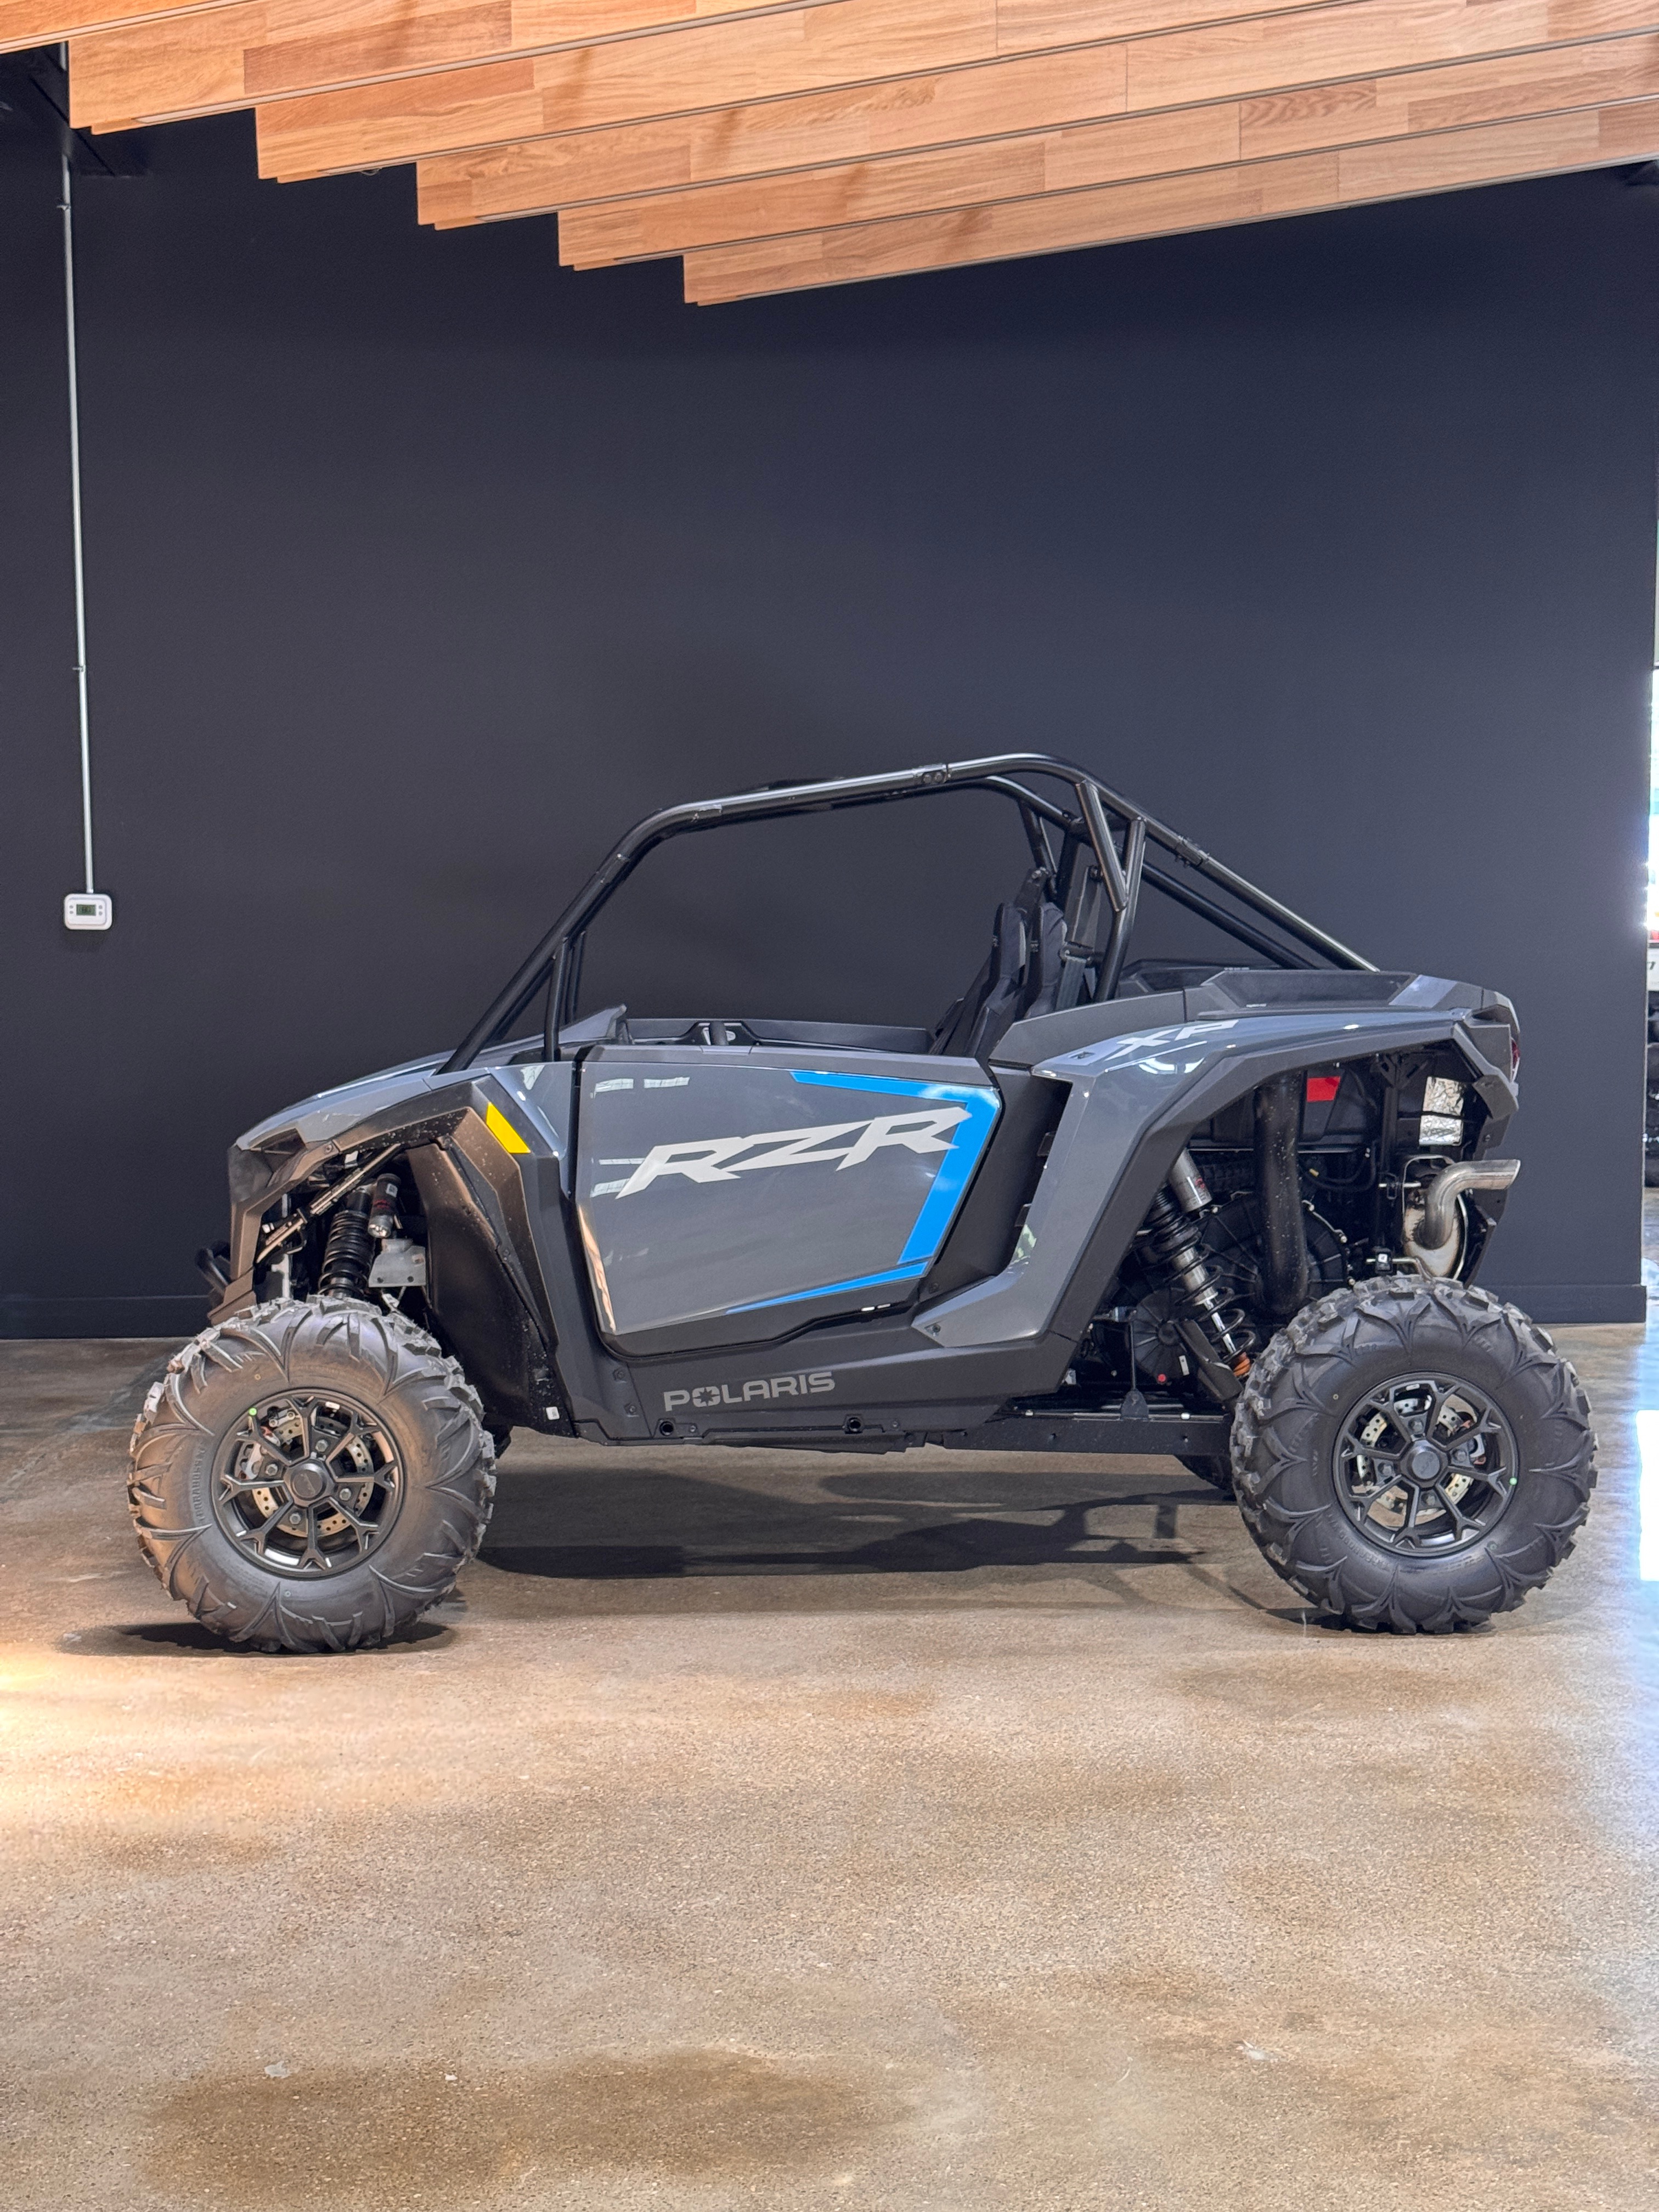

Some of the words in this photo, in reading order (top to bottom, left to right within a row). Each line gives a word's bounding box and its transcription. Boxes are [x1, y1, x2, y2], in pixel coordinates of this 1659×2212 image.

[1104, 1019, 1239, 1061] XP
[616, 1107, 971, 1199] RZR
[664, 1372, 835, 1412] POLARIS
